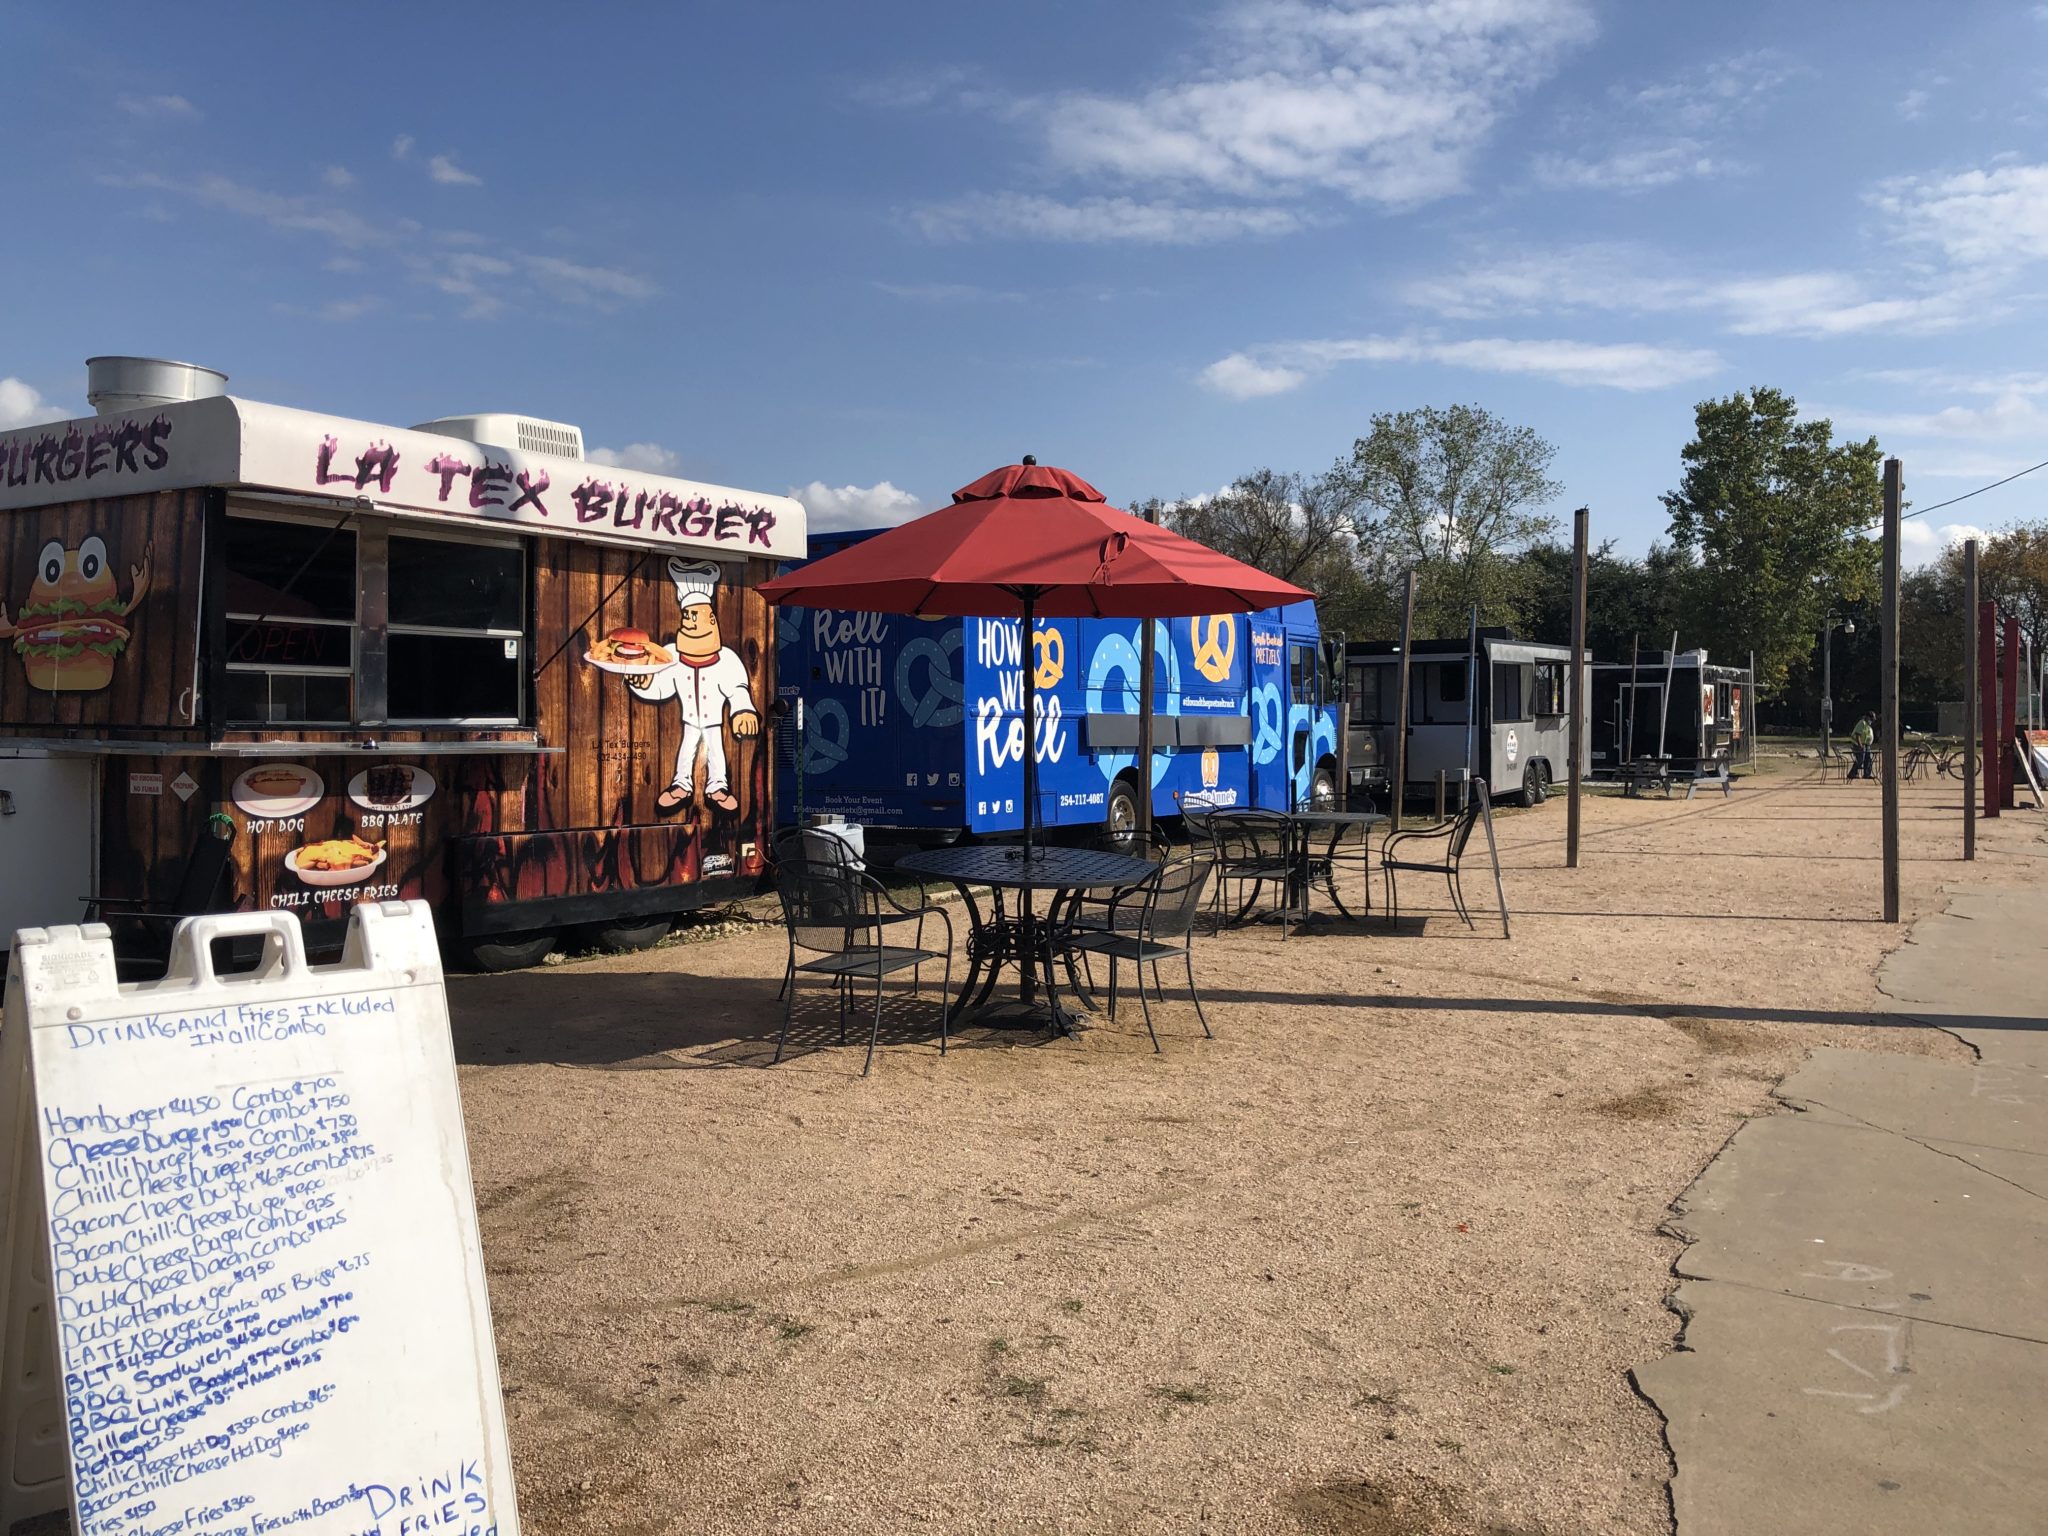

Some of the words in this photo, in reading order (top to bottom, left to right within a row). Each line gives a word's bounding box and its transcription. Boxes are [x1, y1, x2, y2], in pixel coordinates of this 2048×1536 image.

[316, 434, 400, 493] LA
[424, 452, 550, 517] TEX
[571, 475, 777, 548] BURGER
[240, 627, 327, 660] OPEN
[814, 609, 888, 652] Roll
[978, 617, 1025, 669] HOW
[825, 647, 881, 686] WITH
[1256, 648, 1280, 666] PRETZELS
[861, 688, 886, 727] IT!
[977, 693, 1066, 776] Roll
[825, 796, 843, 804] Book
[844, 796, 860, 804] Your
[862, 796, 883, 804] Event
[1060, 793, 1104, 806] 254-717-4087
[246, 820, 275, 834] HOT
[278, 818, 305, 833] DOG
[361, 814, 385, 828] BBQ
[387, 813, 423, 826] PLATE
[271, 892, 309, 908] CHILI
[314, 887, 360, 904] CHEESE
[363, 884, 398, 899] FRIES
[64, 1362, 113, 1396] BLT
[66, 1384, 134, 1418] BBQ
[69, 1405, 140, 1440] BBQ
